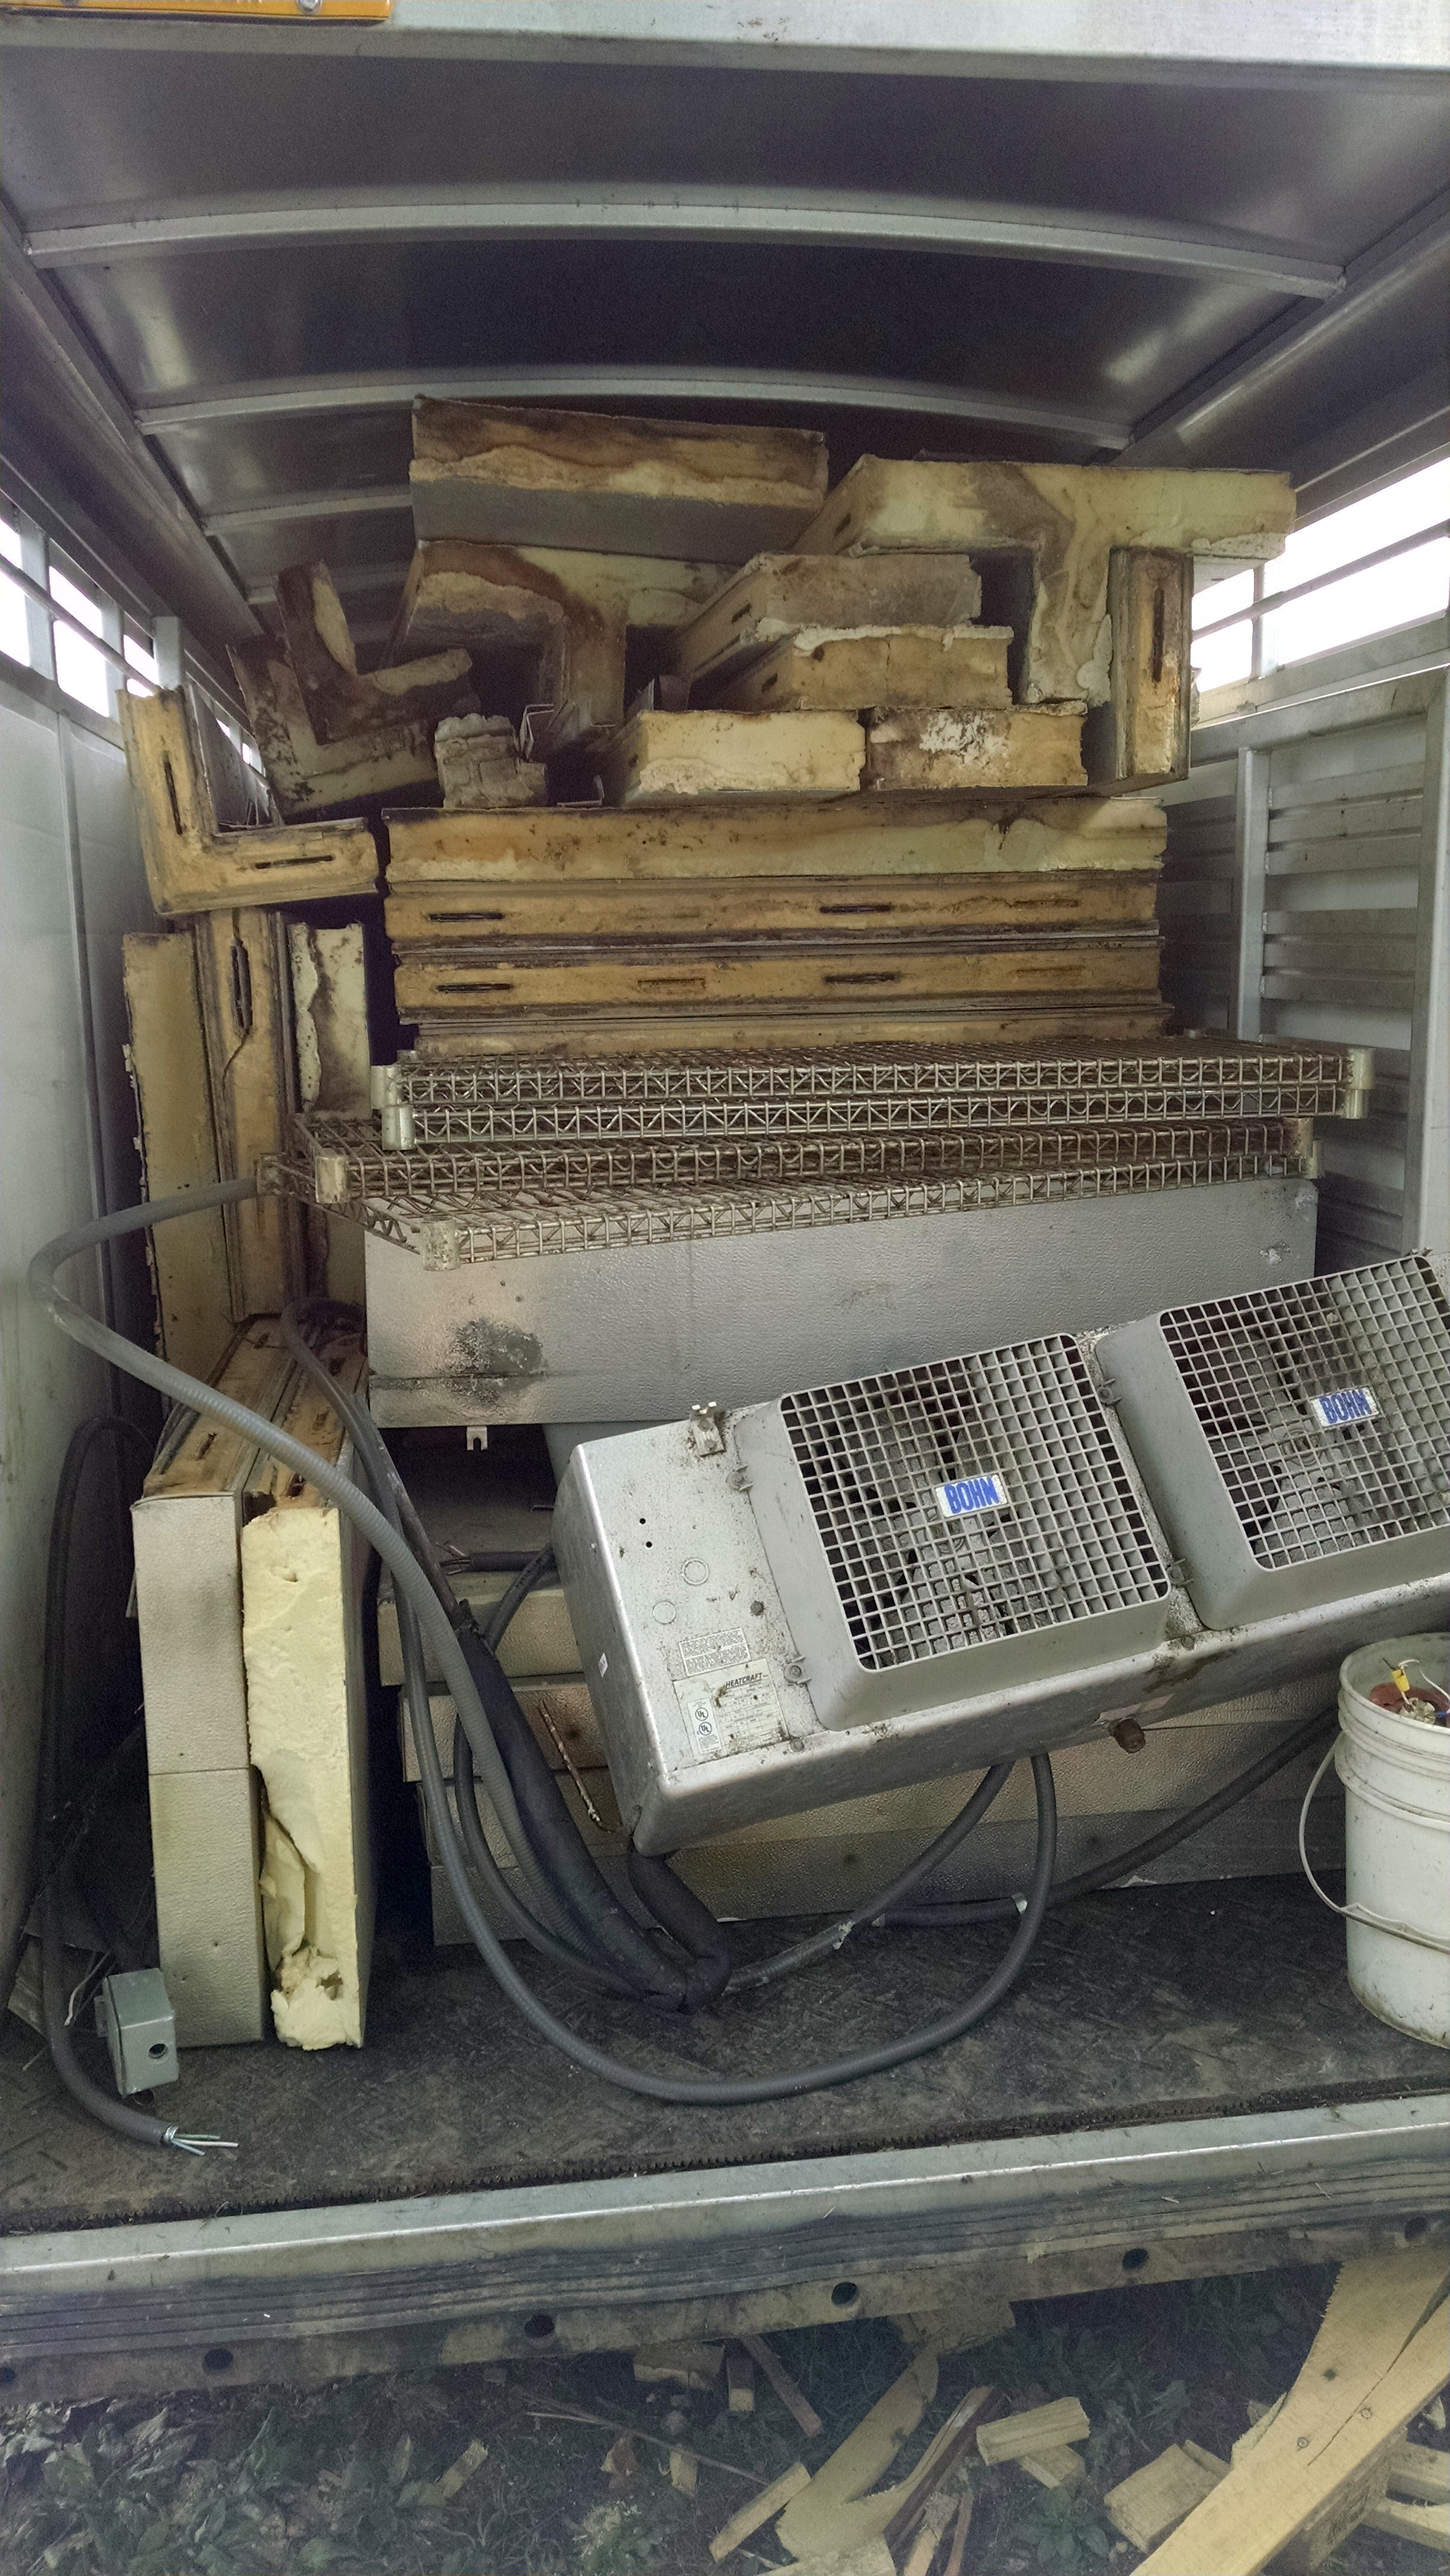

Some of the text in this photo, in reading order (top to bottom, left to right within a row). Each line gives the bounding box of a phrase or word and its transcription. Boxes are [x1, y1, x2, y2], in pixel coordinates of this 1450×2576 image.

[1319, 1389, 1371, 1424] BOHN
[944, 1476, 999, 1514] BOHN
[726, 1672, 763, 1688] HEATCRAFT
